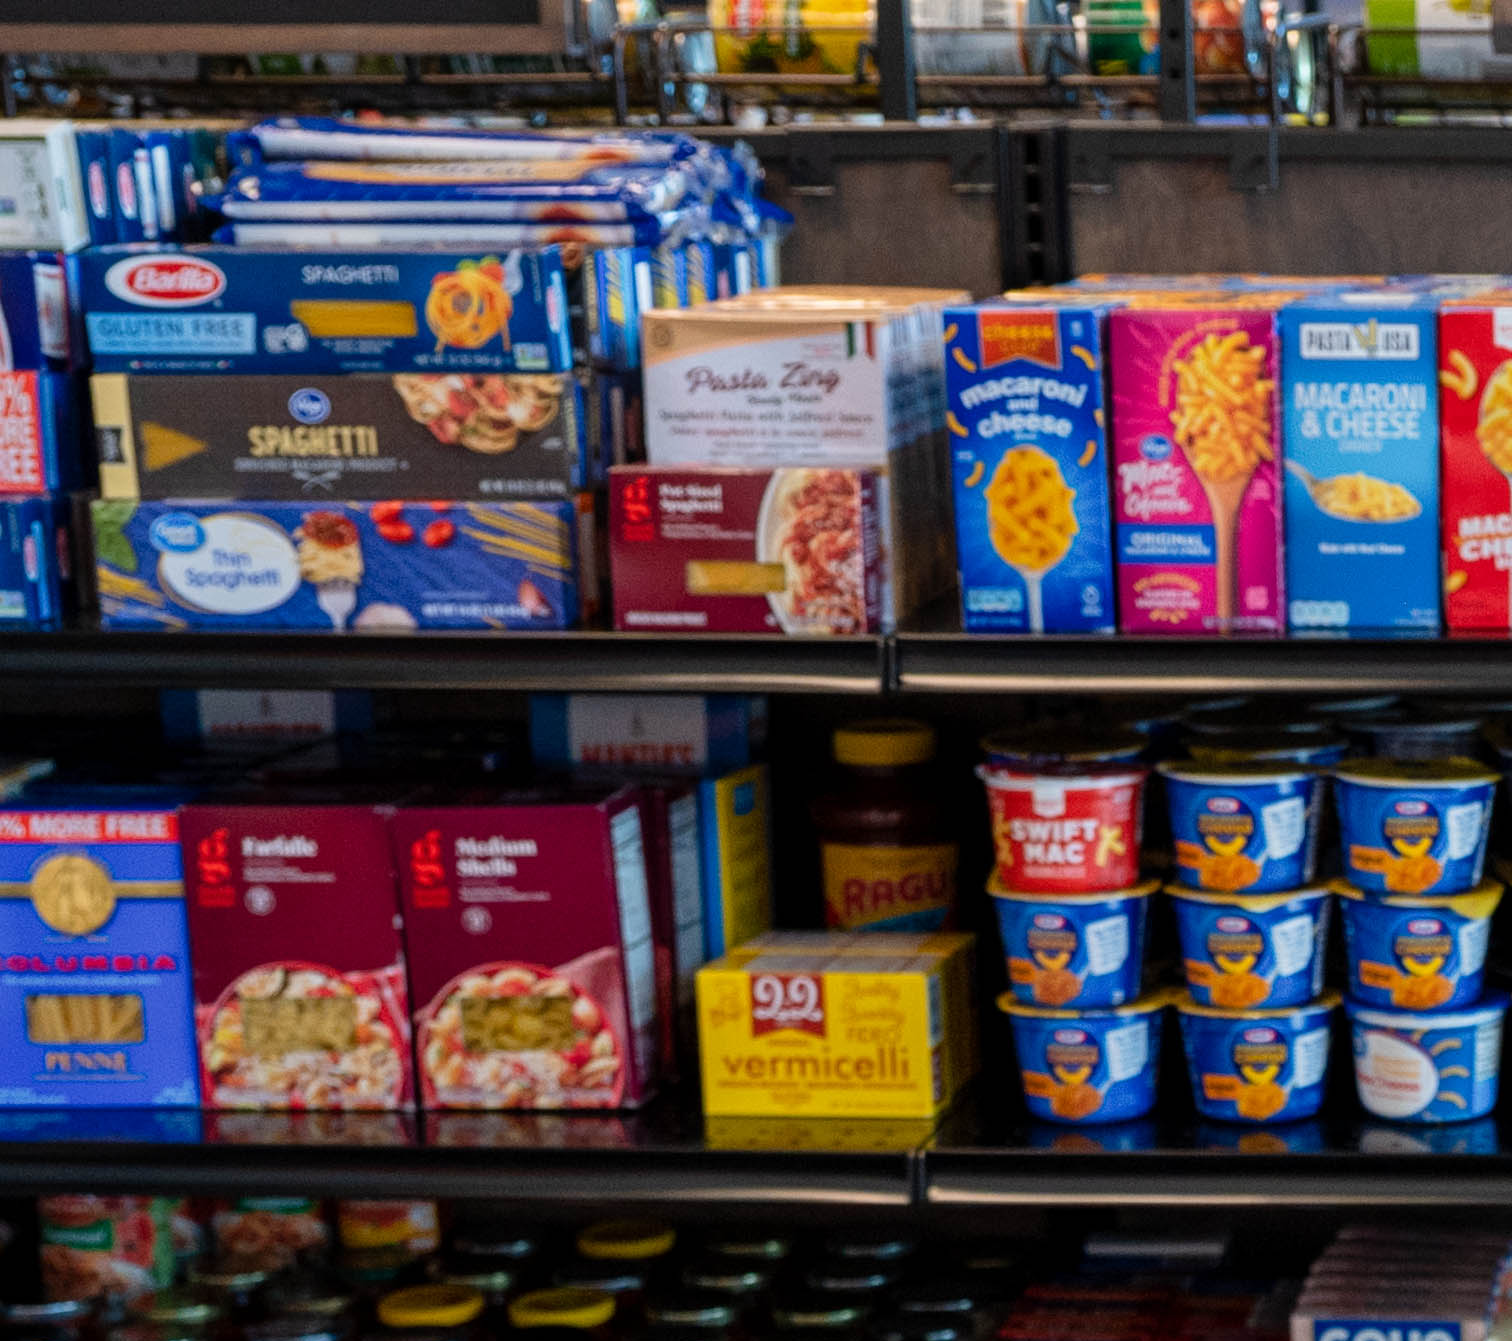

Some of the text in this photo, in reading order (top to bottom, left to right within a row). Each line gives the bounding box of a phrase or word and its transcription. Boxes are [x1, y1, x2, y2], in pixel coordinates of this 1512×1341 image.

[125, 266, 218, 295] Barilla
[302, 265, 398, 284] SPAGHETTI
[96, 317, 246, 339] GLUTEN FREE
[1306, 330, 1352, 354] PASTA
[687, 363, 839, 394] Pasta Zing
[960, 376, 1088, 407] macaroni
[1294, 384, 1426, 410] MACARONI
[1008, 399, 1038, 411] and
[978, 412, 1072, 438] cheese
[1301, 413, 1421, 440] & CHEESE
[248, 427, 379, 458] SPAGHETTI
[211, 548, 252, 568] Thin
[185, 568, 280, 591] Spaghetti
[30, 816, 98, 838] MORE
[106, 815, 168, 837] FREE
[1010, 819, 1097, 842] SWIFT
[242, 838, 318, 858] Farfalle
[456, 837, 538, 857] Medium
[1024, 843, 1085, 865] MAC
[456, 858, 517, 877] Shells
[723, 1047, 911, 1082] vermicelli
